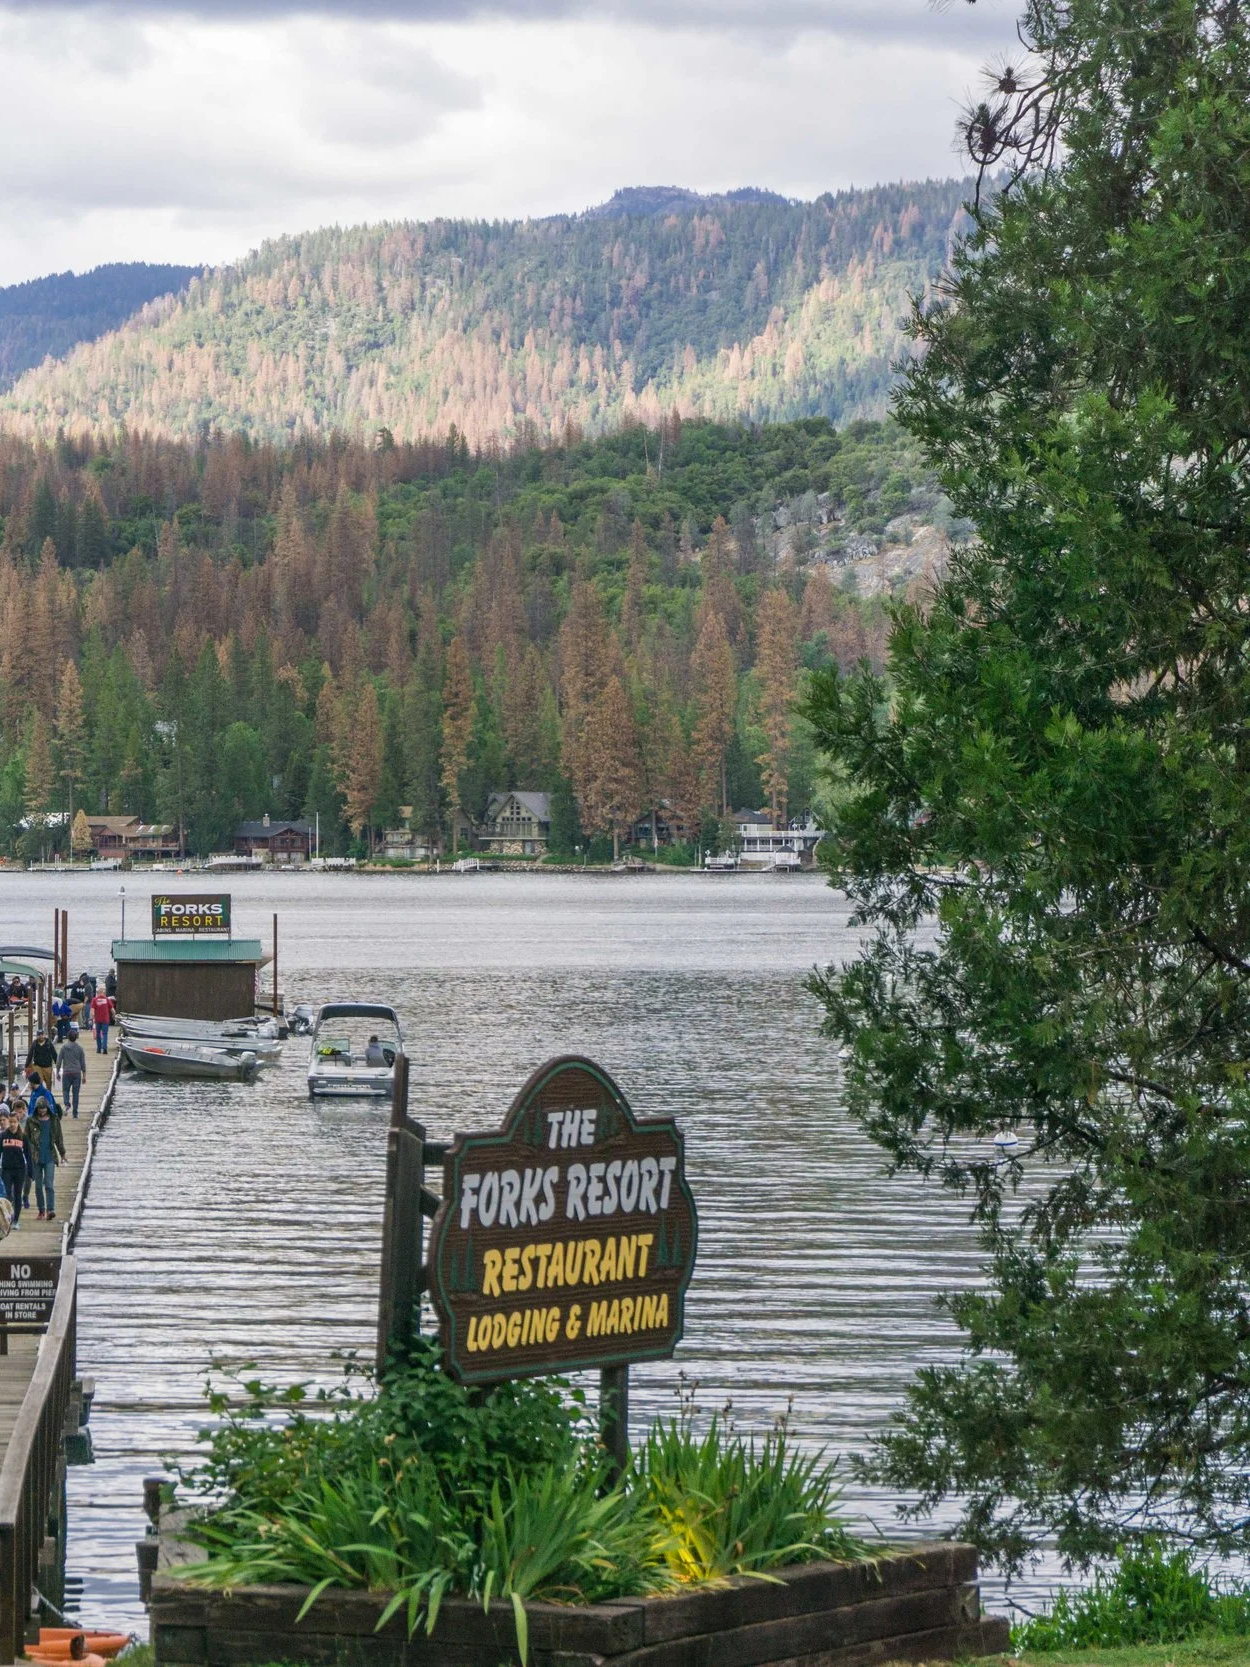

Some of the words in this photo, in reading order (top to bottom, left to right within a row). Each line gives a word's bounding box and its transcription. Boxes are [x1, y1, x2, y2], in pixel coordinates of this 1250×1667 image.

[155, 896, 170, 907] The
[160, 903, 223, 915] FORKS
[160, 916, 223, 927] RESORT
[547, 1108, 597, 1149] THE
[459, 1165, 559, 1230] FORKS
[566, 1156, 677, 1222] RESORT
[10, 1264, 31, 1279] NO
[482, 1233, 654, 1298] RESTAURANT
[18, 1280, 53, 1288] SWIMMING
[5, 1311, 13, 1319] IN
[14, 1311, 37, 1319] STORE
[466, 1306, 561, 1353] LODGING
[565, 1304, 582, 1340] &
[586, 1293, 669, 1337] MARINA
